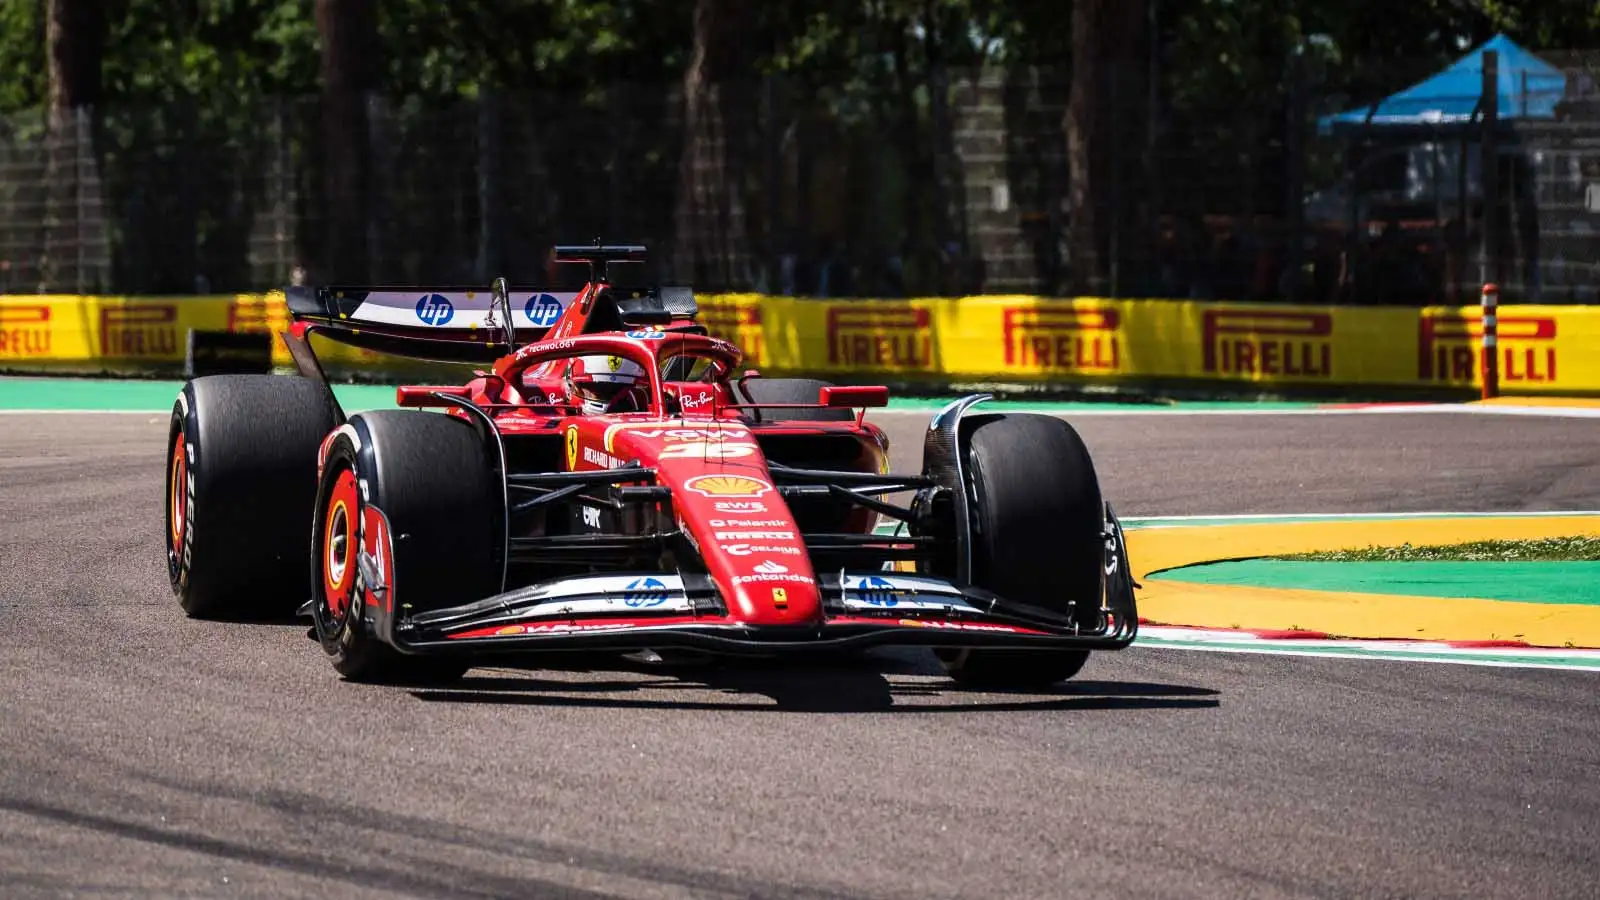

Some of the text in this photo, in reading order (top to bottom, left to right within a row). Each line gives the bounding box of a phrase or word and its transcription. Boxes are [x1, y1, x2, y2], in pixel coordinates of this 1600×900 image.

[420, 294, 450, 326] hp
[529, 294, 558, 326] hp
[102, 306, 177, 356] PIRELLI
[529, 340, 576, 353] TECHNOLOGY
[828, 306, 931, 367] PIRELLI
[1002, 307, 1121, 369] PIRELLI
[1203, 309, 1333, 377] PIRELLI
[1418, 313, 1557, 382] PIRLLI
[628, 429, 749, 438] VGW
[186, 442, 195, 466] P
[584, 446, 608, 469] RICHARD
[184, 471, 195, 571] ZERO
[715, 502, 764, 510] aws
[727, 519, 788, 528] Palantir
[732, 573, 815, 586] Santander
